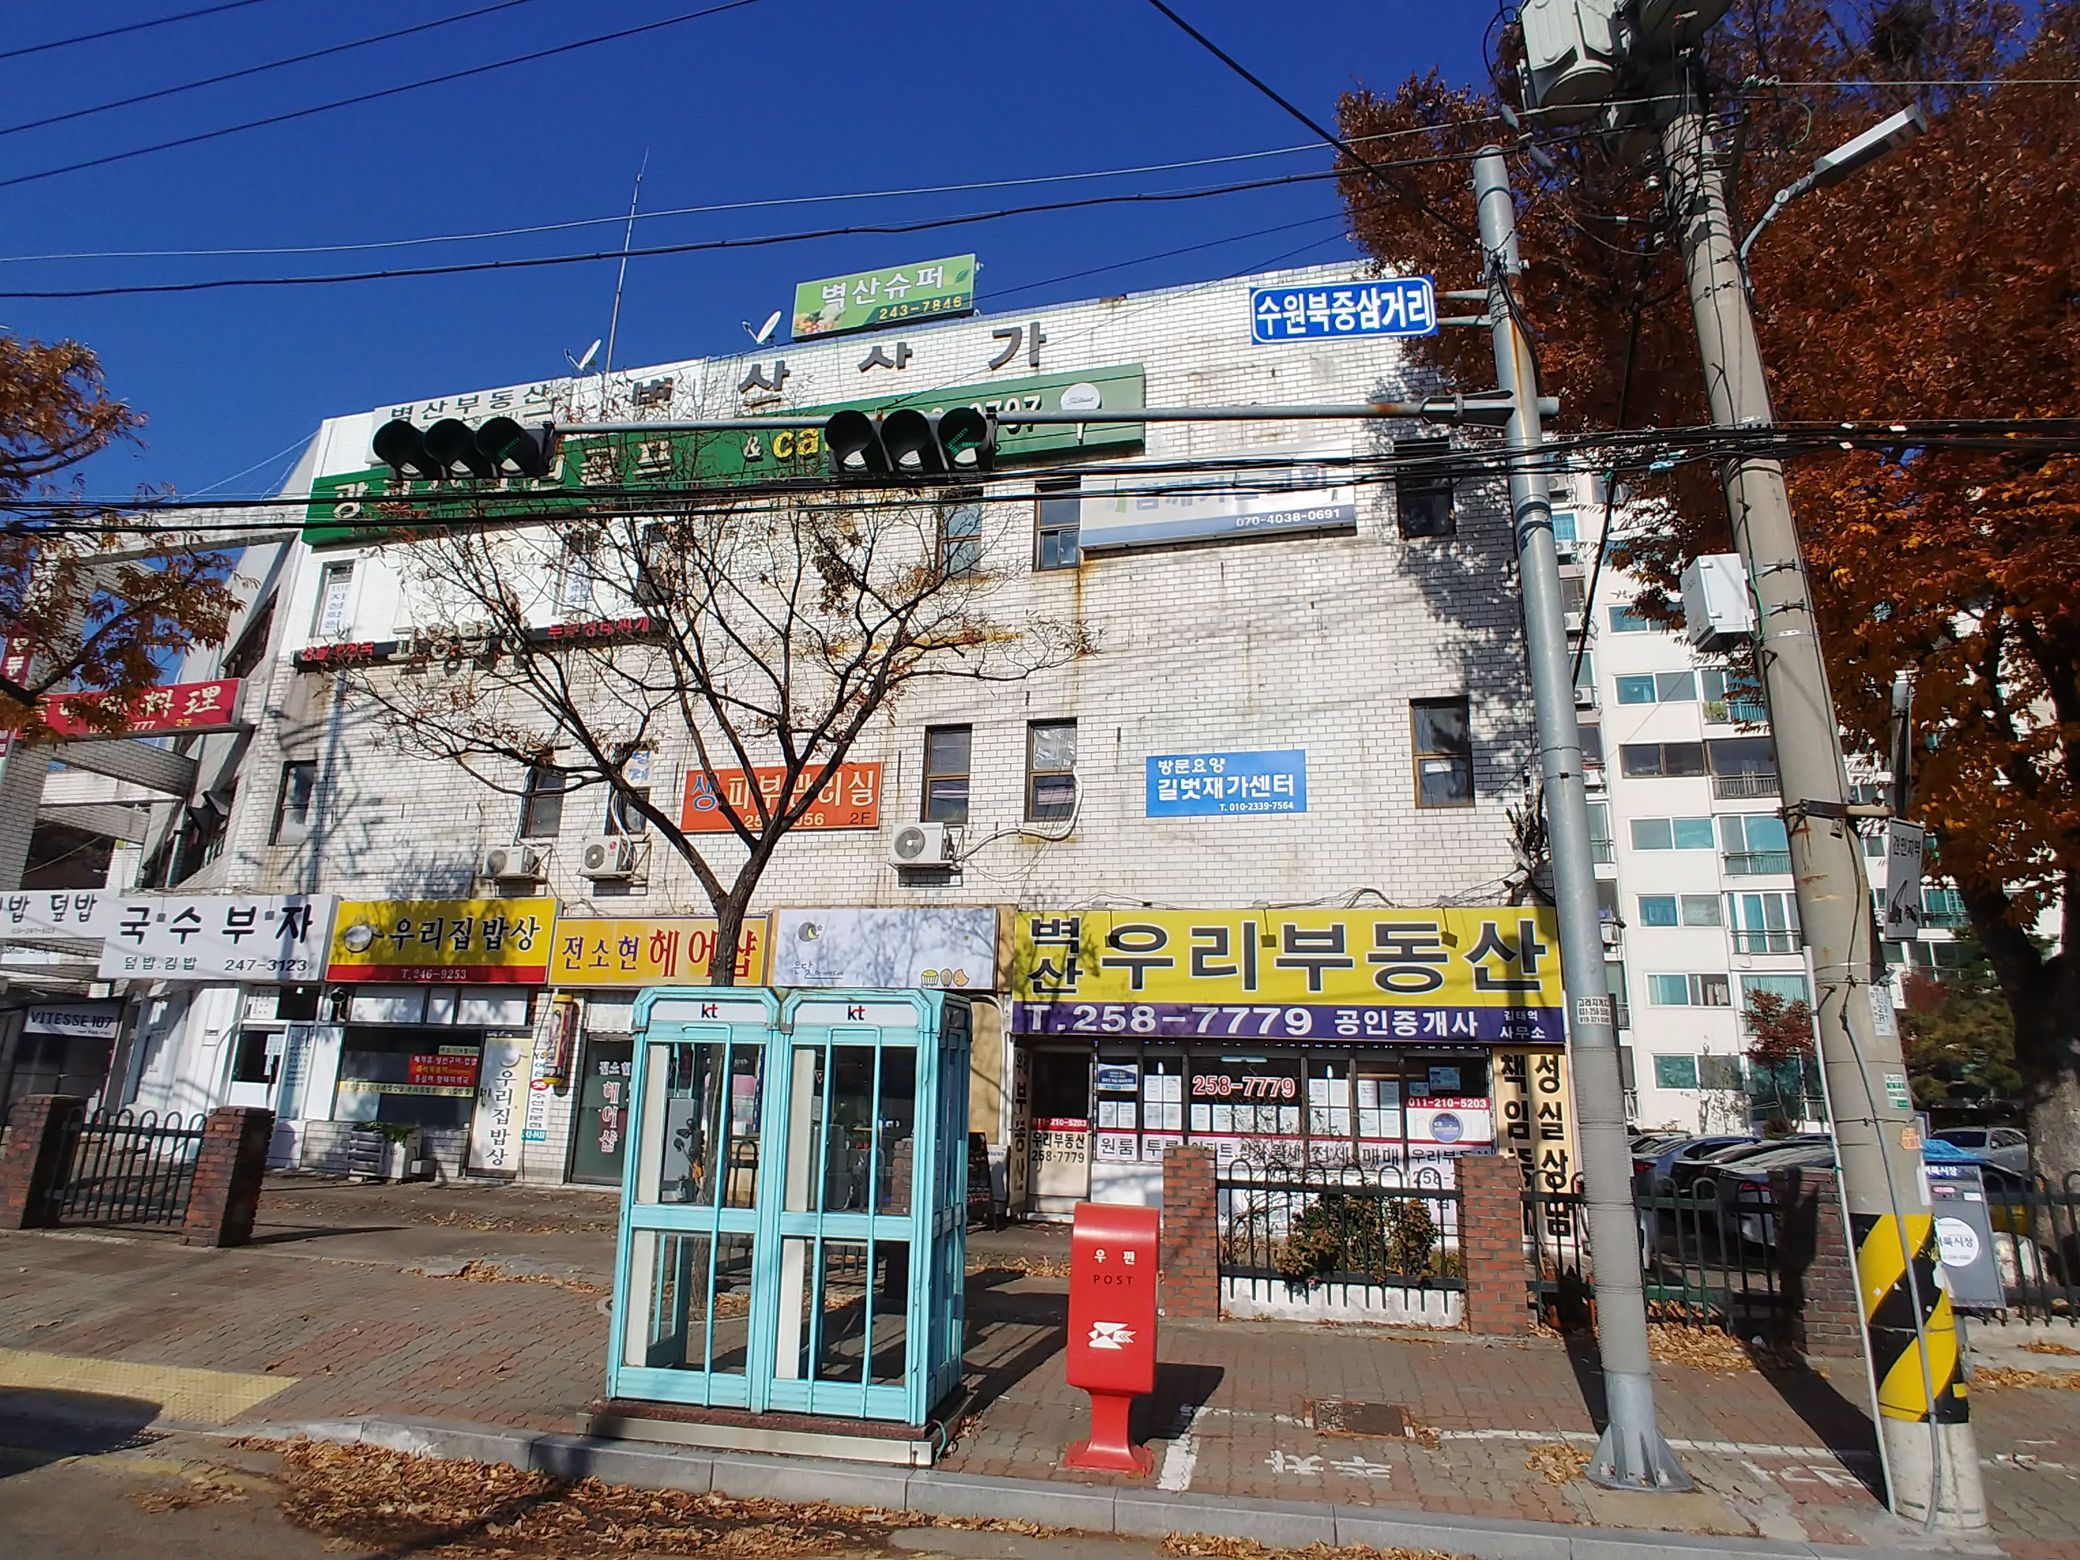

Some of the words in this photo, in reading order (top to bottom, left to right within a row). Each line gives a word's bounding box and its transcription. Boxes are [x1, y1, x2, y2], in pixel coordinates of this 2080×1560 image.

[821, 266, 945, 309] 벽산슈퍼
[879, 296, 963, 320] 243-7846
[1257, 284, 1432, 336] 수원북중삼거리
[1236, 508, 1342, 527] 070-4038-0691
[1157, 757, 1196, 776] 방문요양
[727, 769, 874, 811] 피부관리실
[1157, 773, 1295, 801] 길벗재가센터
[1219, 803, 1228, 812] T.
[1229, 801, 1295, 812] 010-2339-7564
[850, 812, 872, 825] 2F
[0, 894, 31, 924] 밥
[49, 893, 98, 923] 덮밥
[119, 904, 314, 946] 국수부자
[562, 935, 640, 970] 전소현
[1026, 916, 1085, 995] 벽산
[1099, 918, 1549, 995] 우리부동산
[223, 959, 308, 973] 247-3123
[30, 1010, 88, 1028] VITESSE
[700, 1003, 719, 1020] kt
[847, 1005, 866, 1021] kt
[1503, 1009, 1539, 1022] 김태억
[1333, 1008, 1479, 1038] 공인중개사
[1499, 1025, 1547, 1040] 사무소
[1192, 1074, 1297, 1099] 258-7779
[1407, 1097, 1488, 1109] 011-210-5203
[1032, 1132, 1086, 1150] 우리부동산
[1100, 1137, 1135, 1156] 원룸
[1031, 1150, 1086, 1164] 258-7779
[1312, 1144, 1350, 1163] 전세
[1363, 1148, 1400, 1166] 매매
[1093, 1248, 1136, 1265] 우편
[1093, 1274, 1134, 1285] POST
